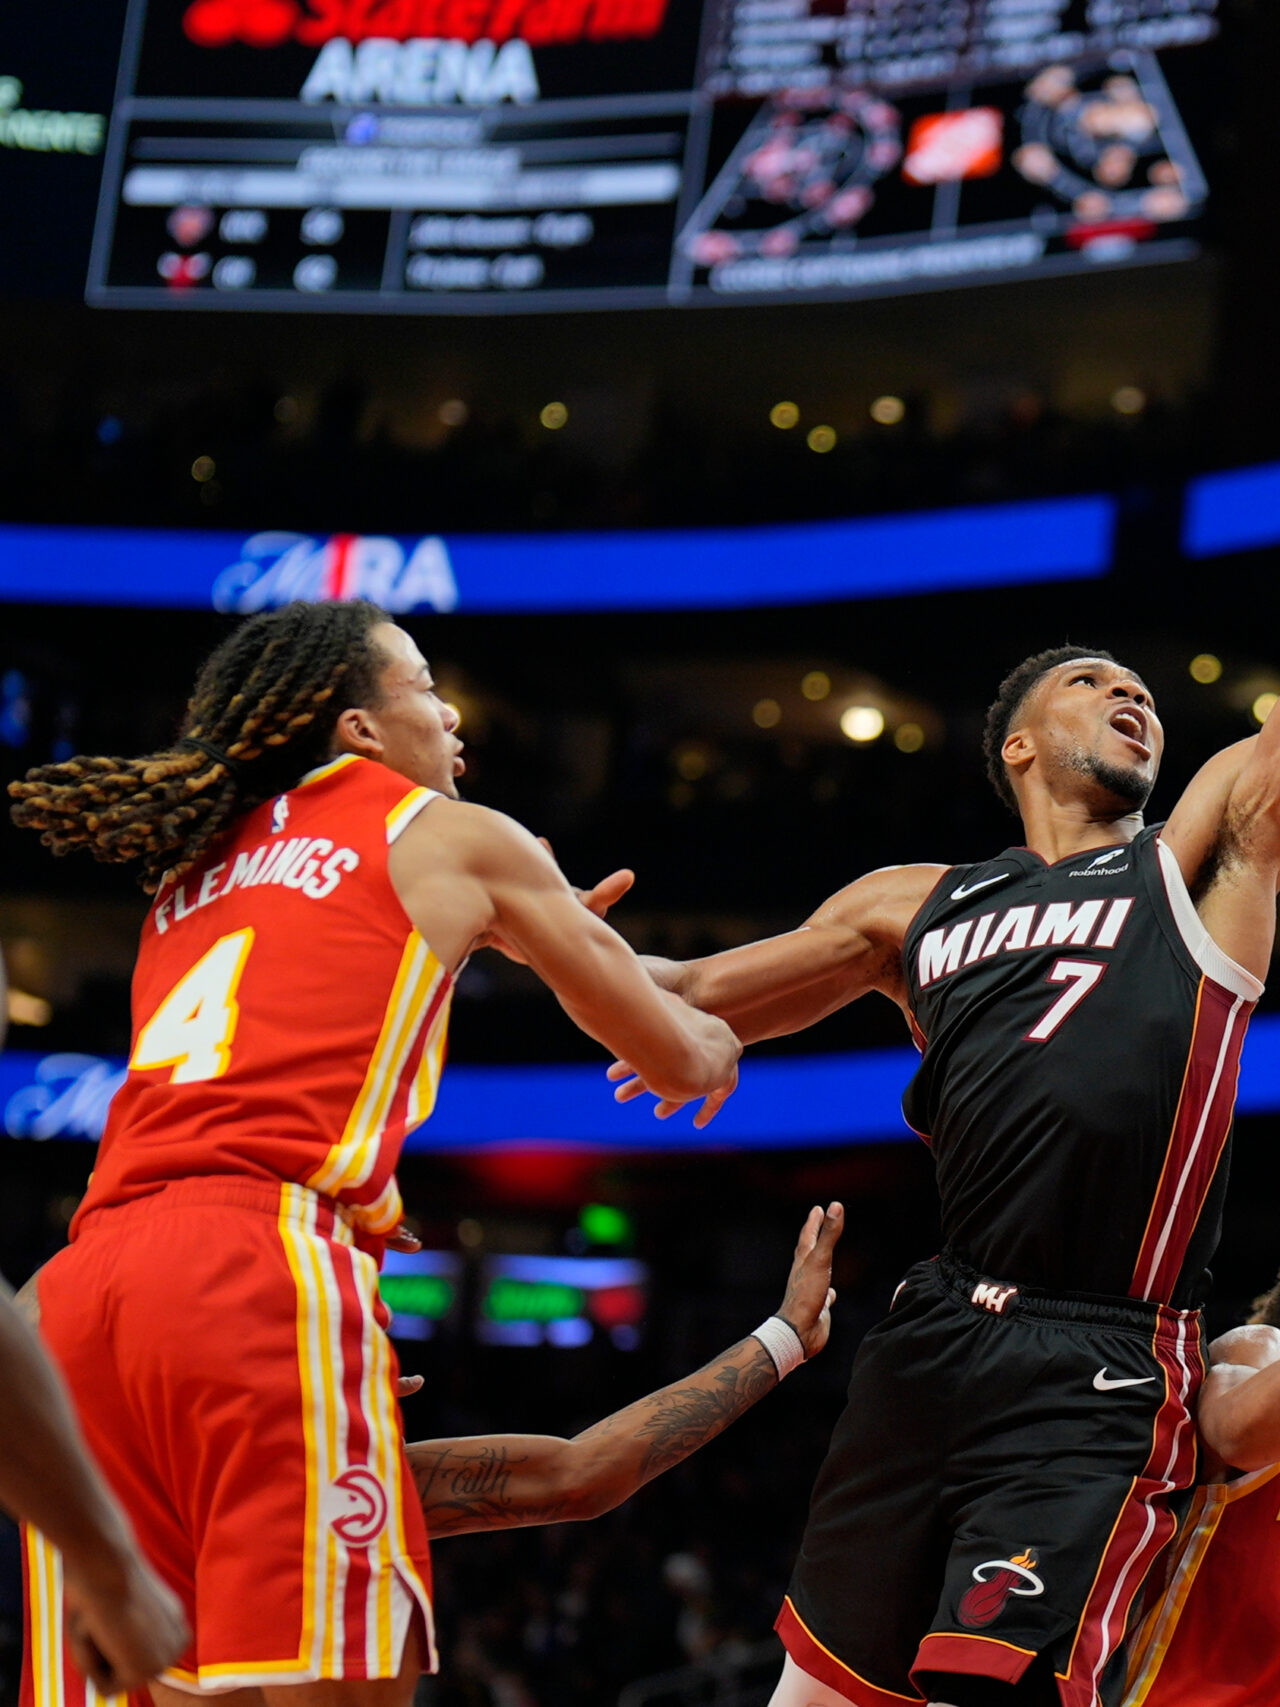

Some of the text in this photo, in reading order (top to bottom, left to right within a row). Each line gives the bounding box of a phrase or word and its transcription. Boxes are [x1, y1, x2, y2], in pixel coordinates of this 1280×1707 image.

[301, 37, 540, 104] ARENA
[155, 837, 360, 935] FLEMINGS
[1068, 863, 1130, 878] Robinhood
[917, 896, 1136, 991] MIAMI
[128, 926, 256, 1085] 4
[1022, 957, 1110, 1043] 7
